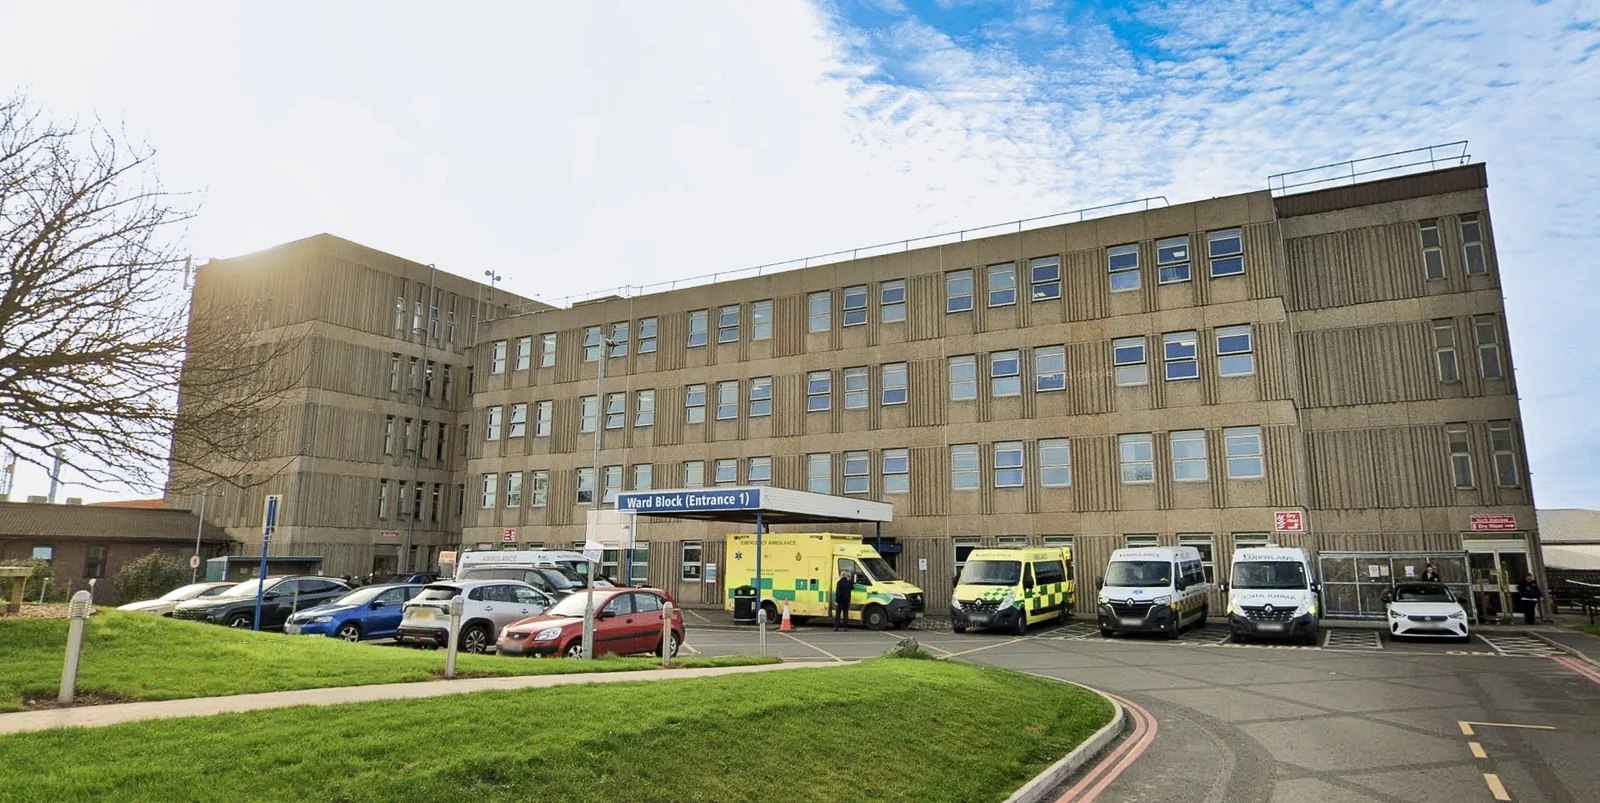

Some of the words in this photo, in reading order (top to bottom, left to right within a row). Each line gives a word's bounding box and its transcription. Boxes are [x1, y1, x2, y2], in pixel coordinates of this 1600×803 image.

[627, 496, 652, 509] Ward
[655, 494, 683, 507] Block
[685, 494, 735, 508] (Entrance
[739, 492, 750, 506] 1)
